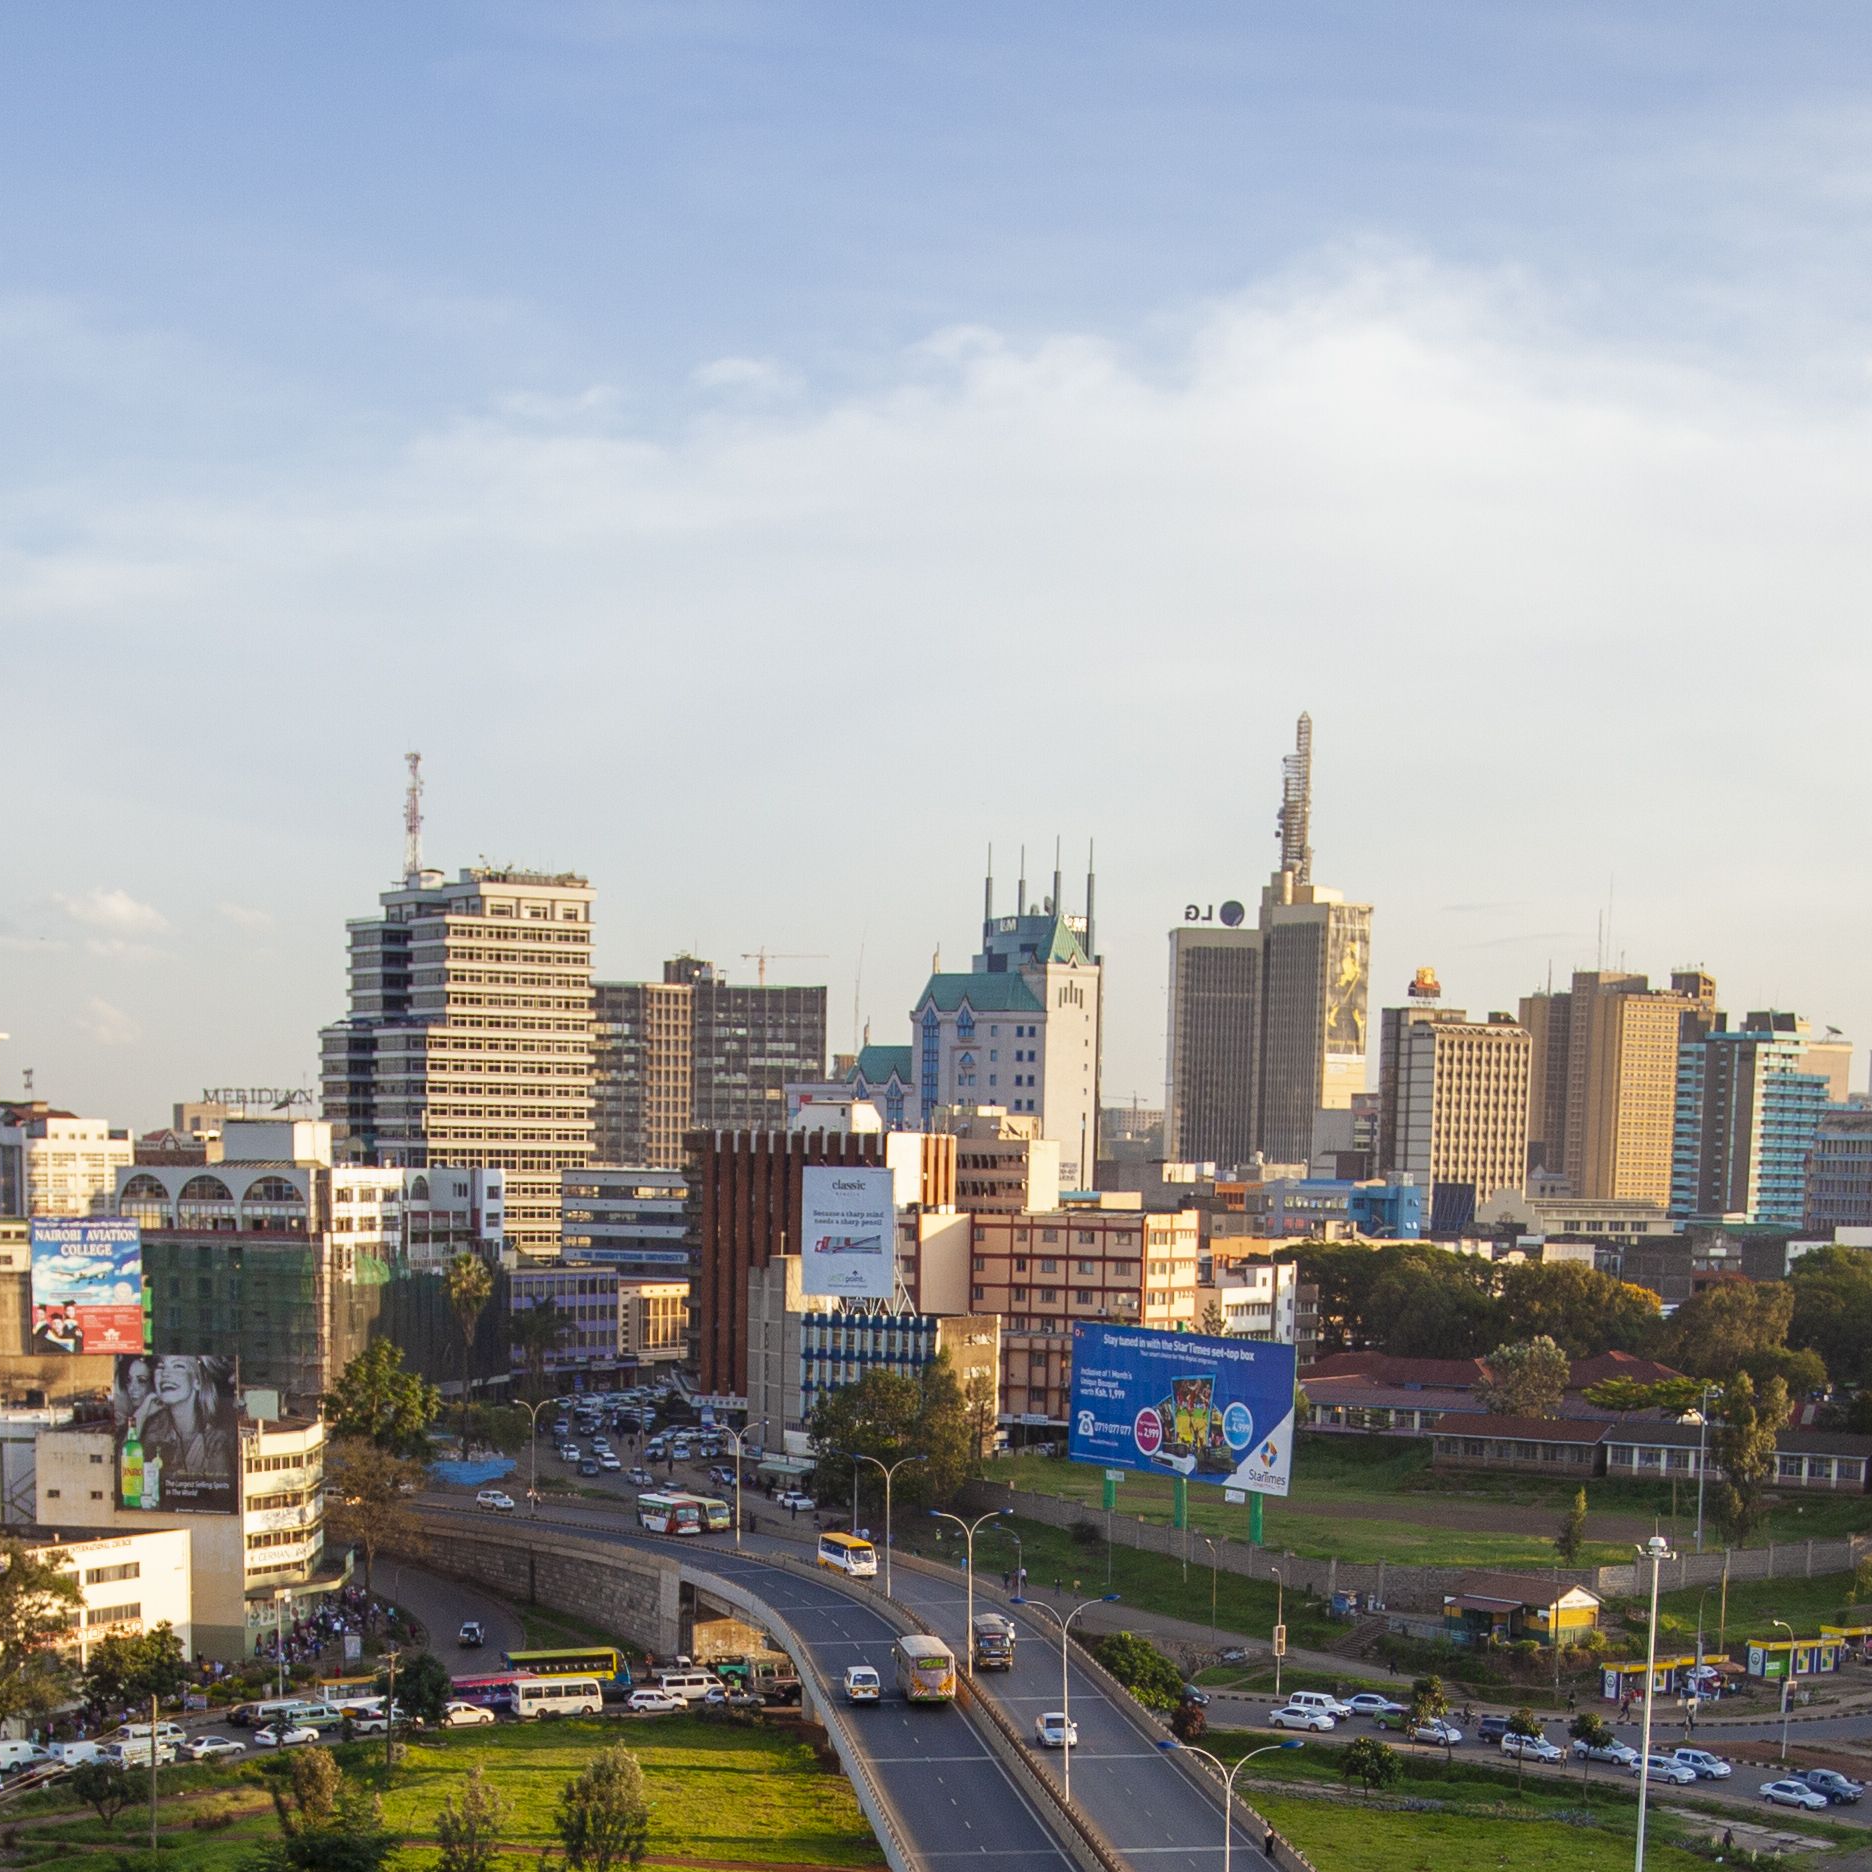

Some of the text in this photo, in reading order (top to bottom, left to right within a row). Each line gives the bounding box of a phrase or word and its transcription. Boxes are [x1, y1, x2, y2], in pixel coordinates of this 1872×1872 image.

[202, 1088, 314, 1105] MERIDIAN
[831, 1180, 866, 1191] classic
[35, 1229, 137, 1241] NAIROBI AVIATION
[60, 1243, 113, 1256] COLLEGE
[1103, 1333, 1118, 1348] Stay
[1139, 1336, 1146, 1348] in
[1162, 1339, 1173, 1351] the
[1211, 1347, 1239, 1362] set-top
[1240, 1349, 1255, 1361] box
[1109, 1389, 1125, 1399] 1,999
[1249, 1468, 1286, 1486] StarTimes
